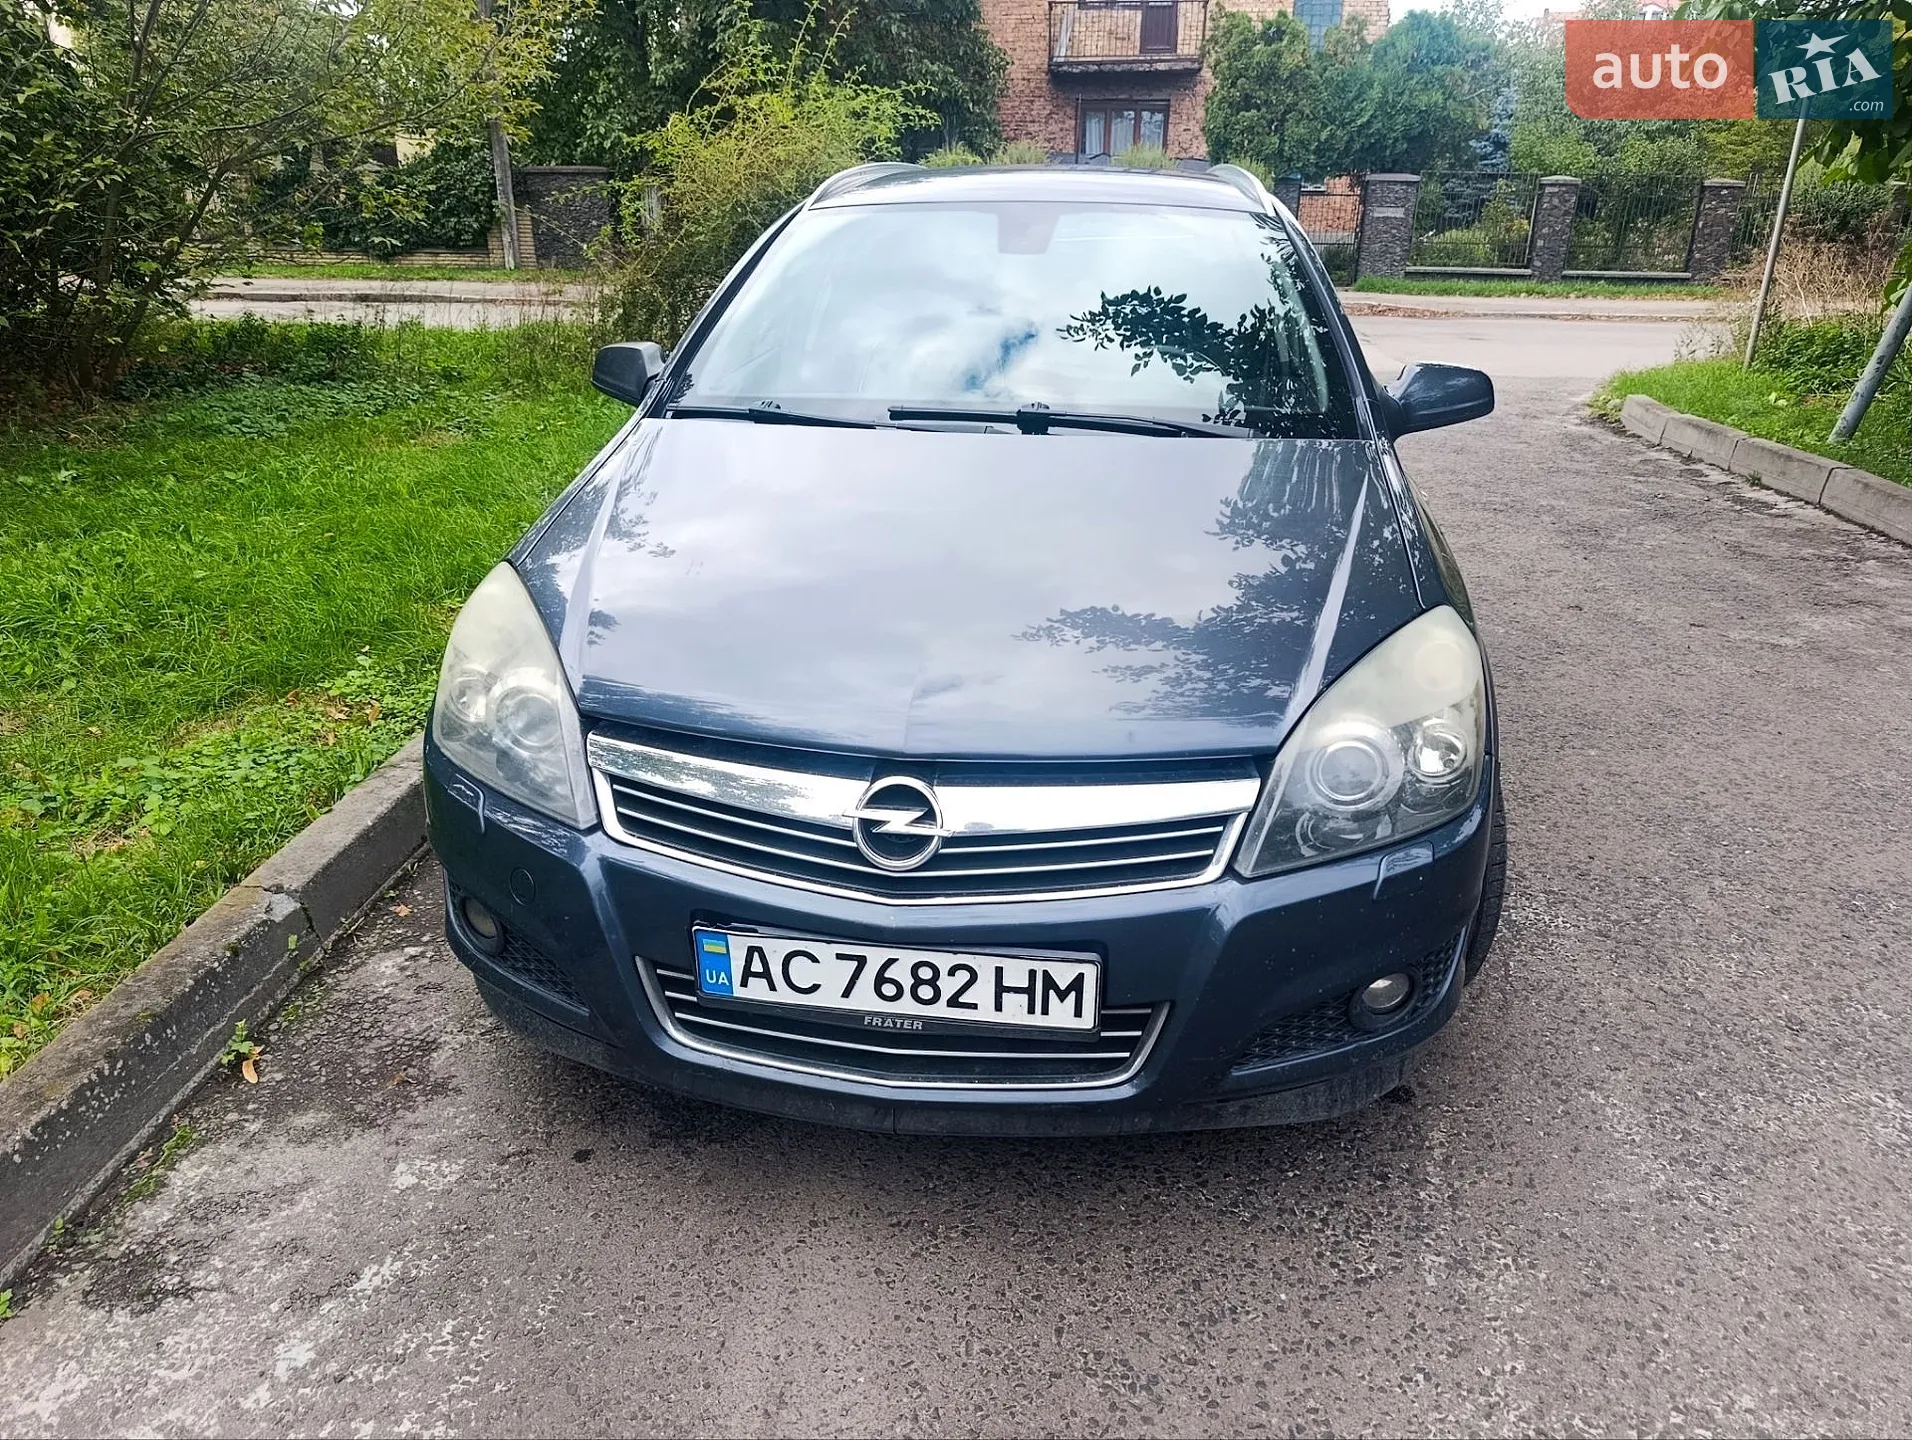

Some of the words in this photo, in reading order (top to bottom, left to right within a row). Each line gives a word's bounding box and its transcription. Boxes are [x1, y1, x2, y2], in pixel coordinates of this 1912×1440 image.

[706, 968, 730, 986] UA
[739, 945, 822, 995] AC
[835, 952, 979, 1011] 7682
[994, 965, 1086, 1019] HM
[863, 1016, 923, 1030] FRATER
